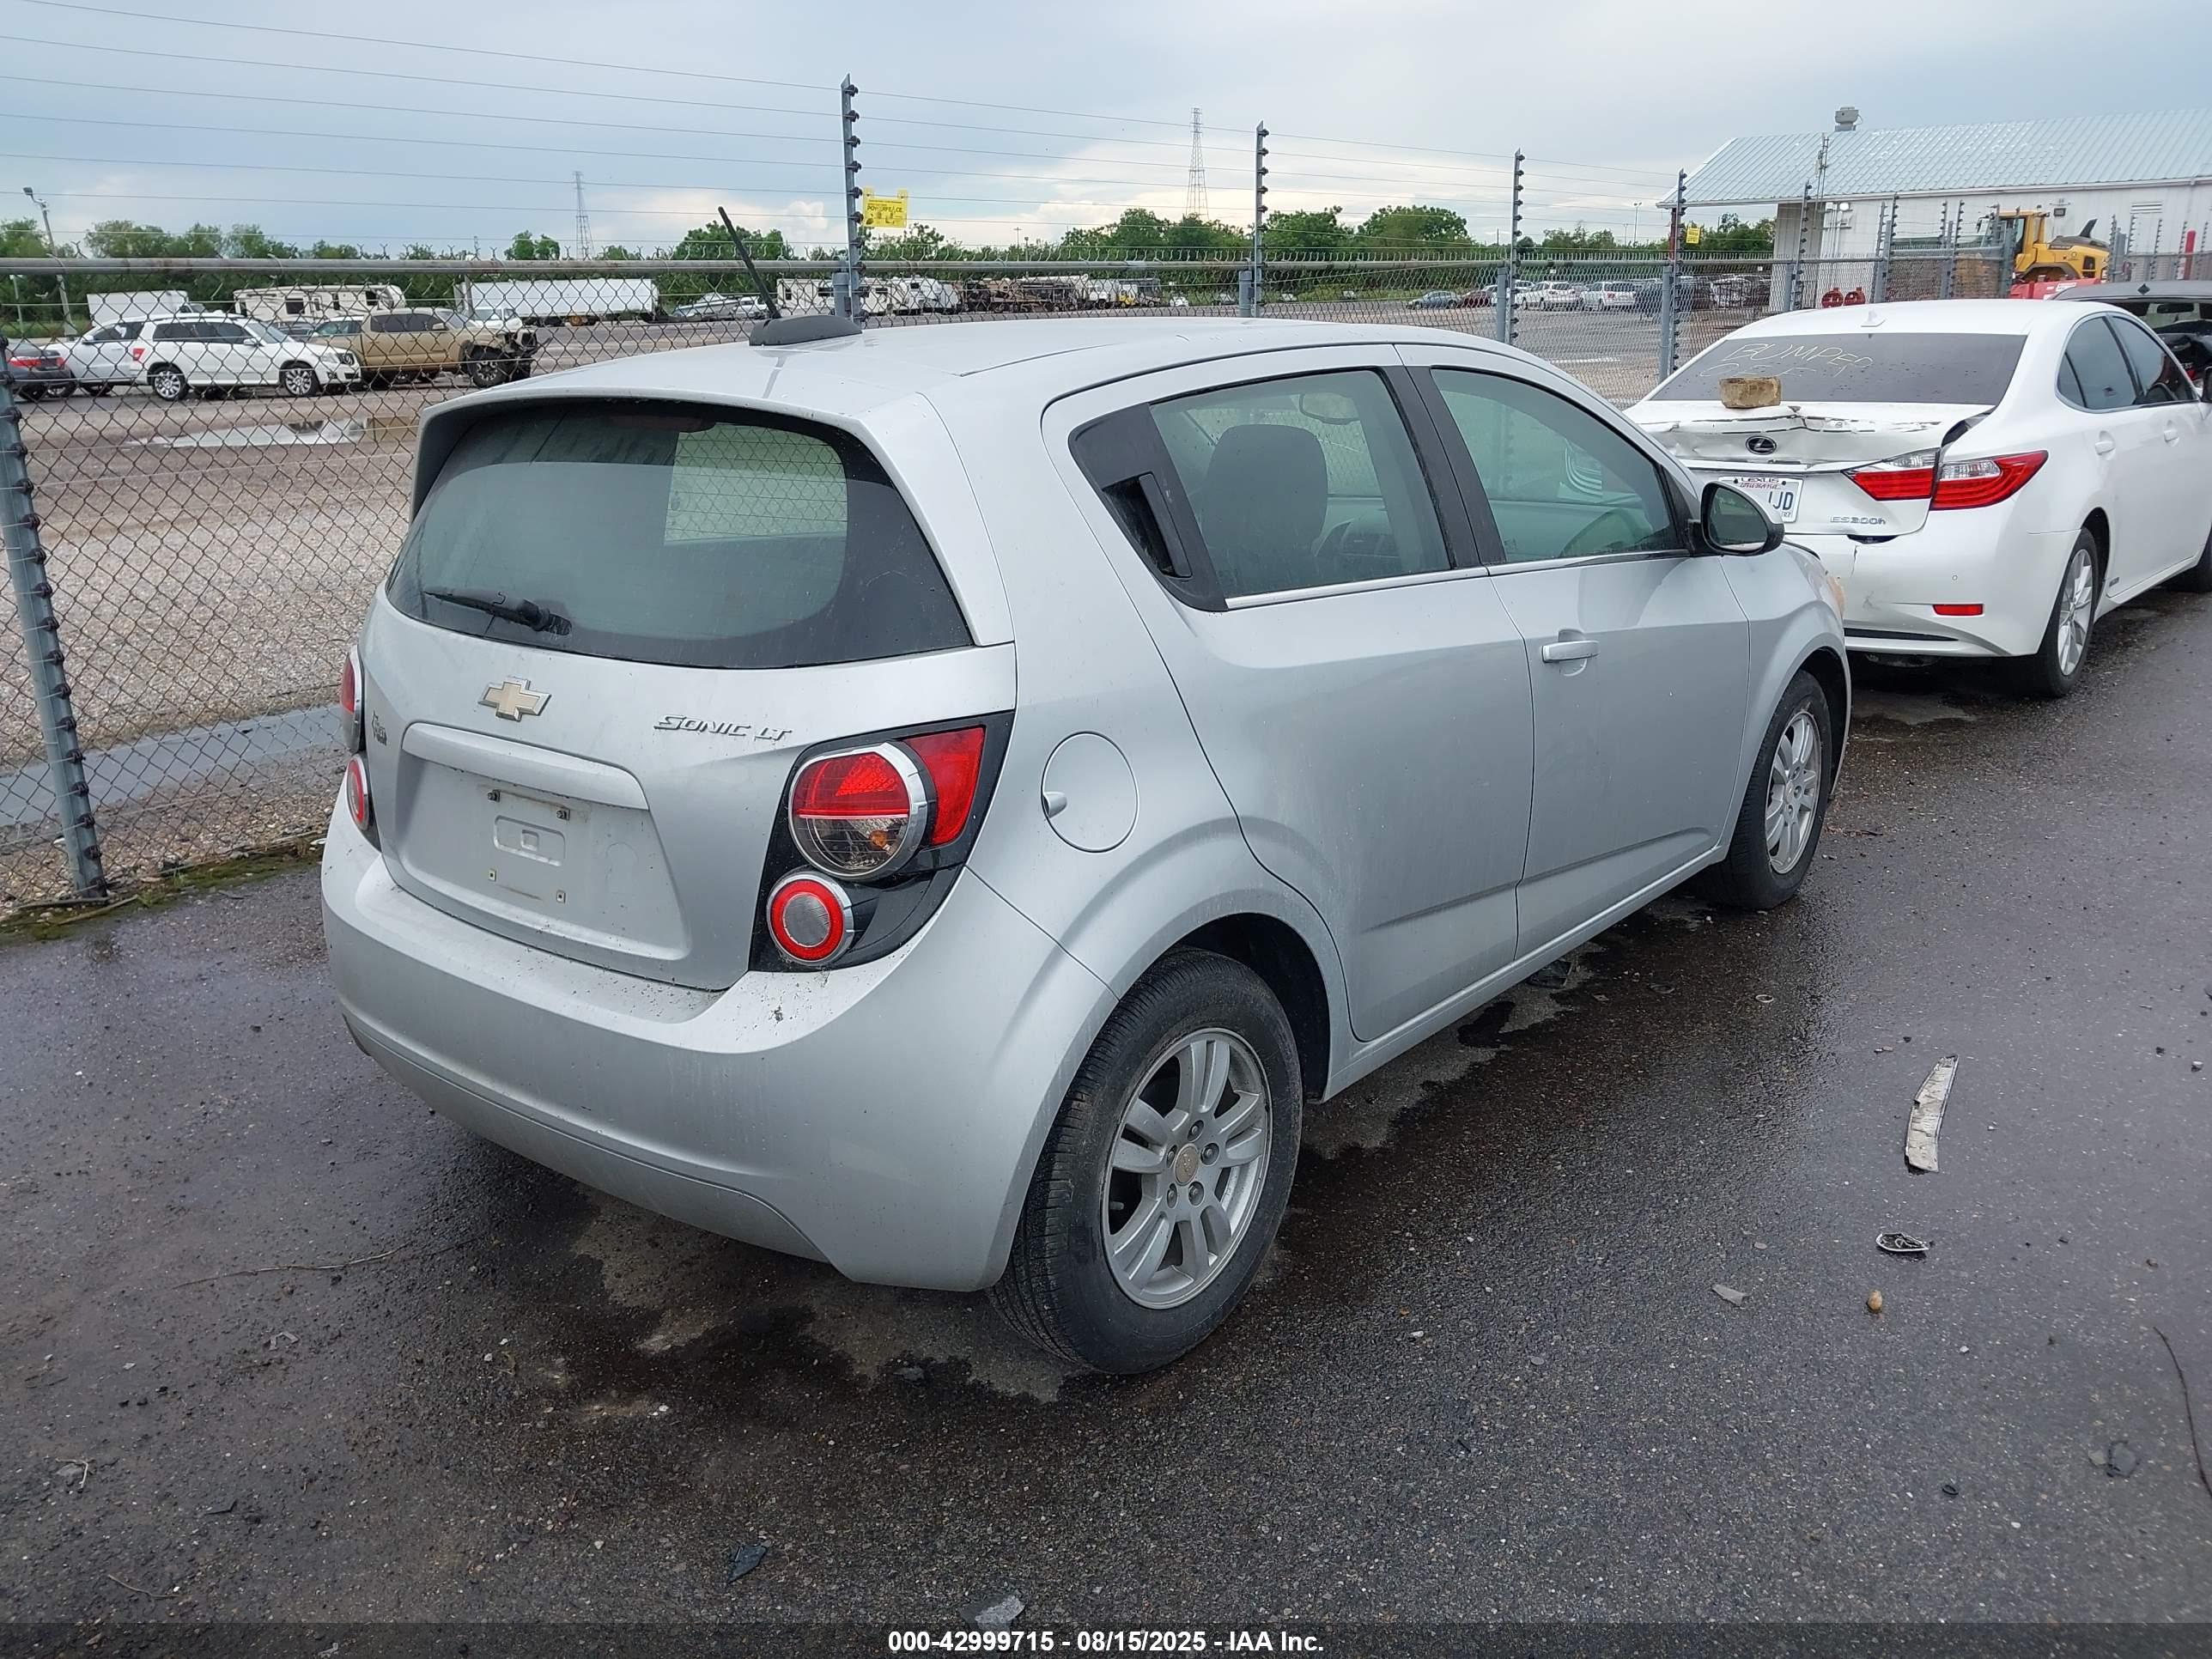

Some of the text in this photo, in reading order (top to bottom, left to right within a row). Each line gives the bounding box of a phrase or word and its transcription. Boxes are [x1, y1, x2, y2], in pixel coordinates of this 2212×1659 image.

[1720, 343, 1874, 376] BUMPER
[653, 715, 793, 741] SONIC LT
